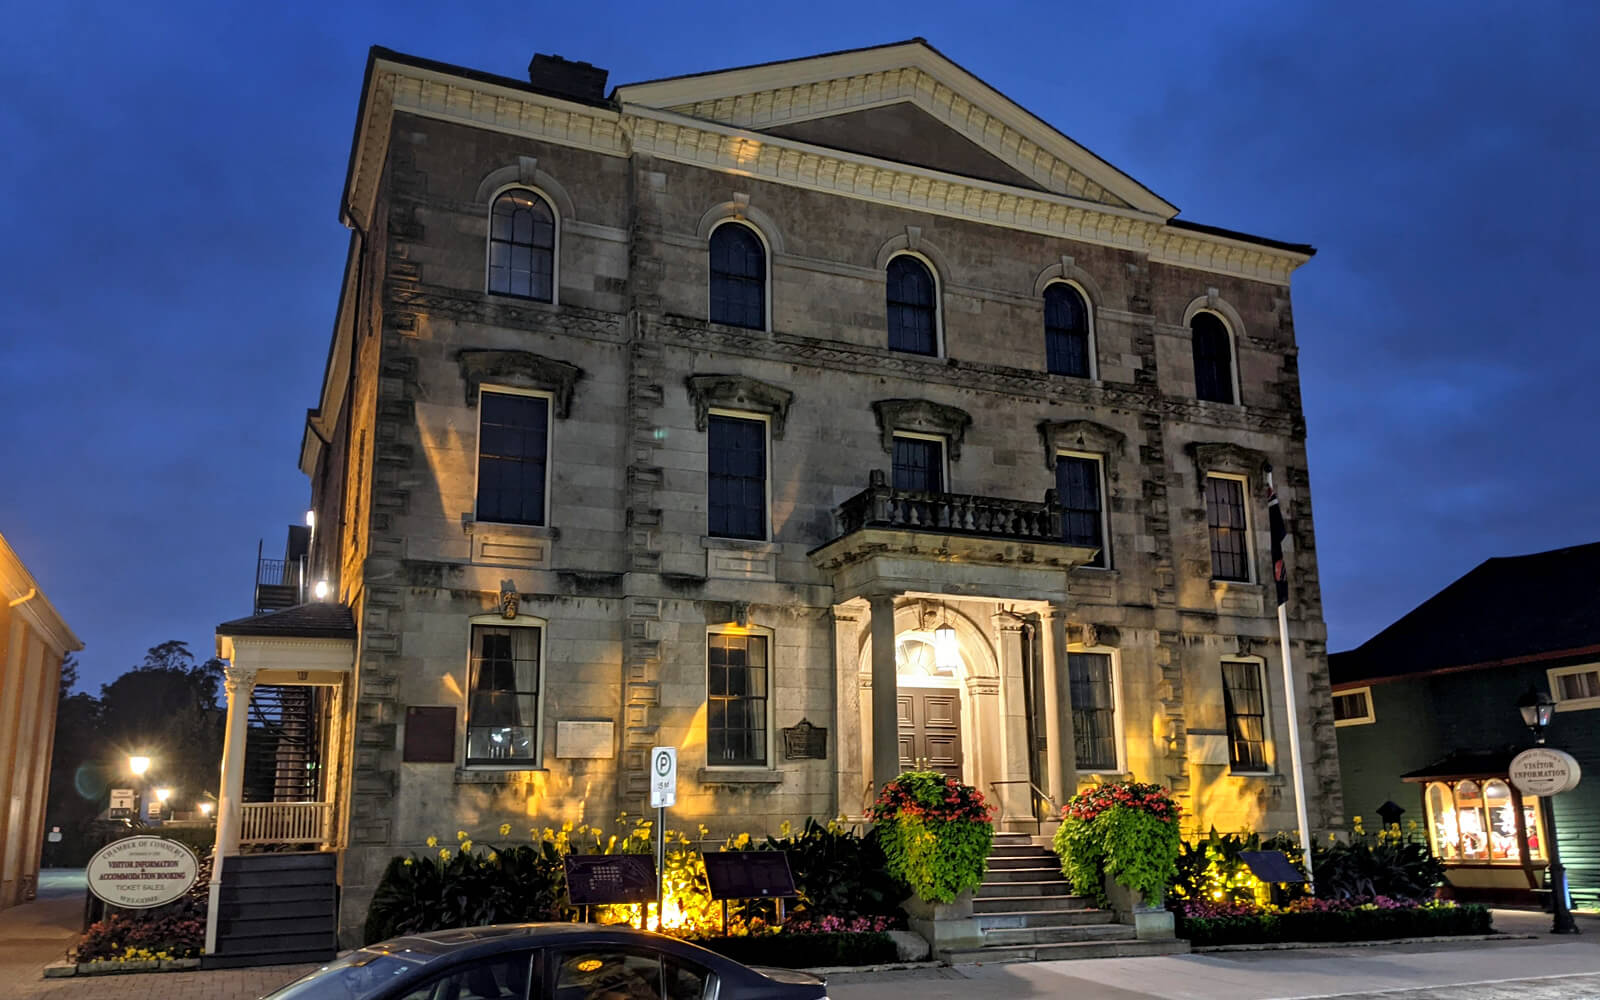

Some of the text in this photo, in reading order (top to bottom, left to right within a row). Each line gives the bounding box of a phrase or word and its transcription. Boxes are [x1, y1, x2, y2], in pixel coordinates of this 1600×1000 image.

[660, 756, 667, 770] P
[1523, 761, 1554, 769] VISITOR
[1513, 770, 1566, 779] INFORMATION
[102, 841, 137, 860] CHAMBER
[135, 860, 179, 868] INFORMATION
[99, 872, 186, 880] ACCOMMODATION BOOKING
